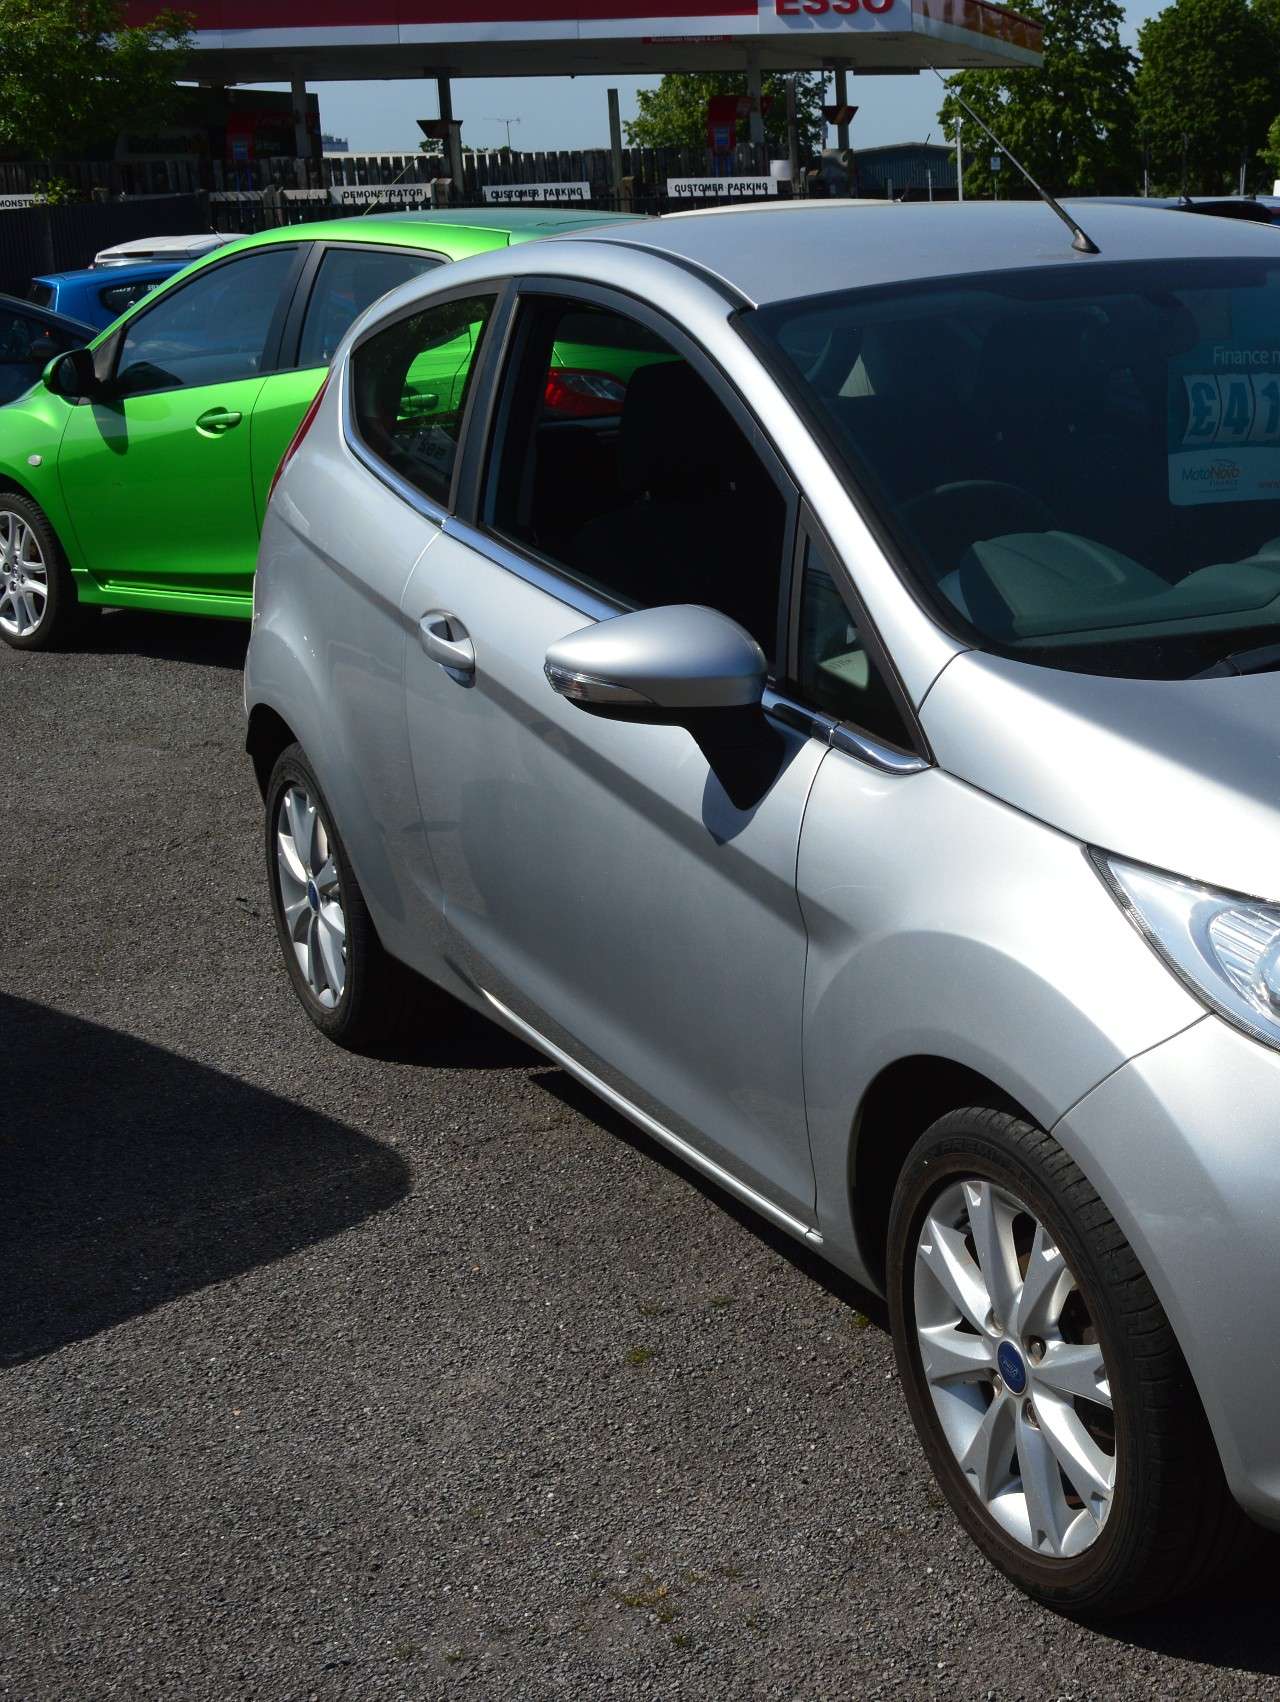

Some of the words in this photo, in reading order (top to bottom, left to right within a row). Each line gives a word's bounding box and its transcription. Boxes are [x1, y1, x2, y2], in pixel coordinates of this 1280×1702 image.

[490, 189, 540, 200] CUSTOMER
[543, 187, 583, 198] PARKING
[674, 183, 724, 193] CUSTOMER
[728, 182, 769, 192] PARKING
[1213, 346, 1269, 366] Finance
